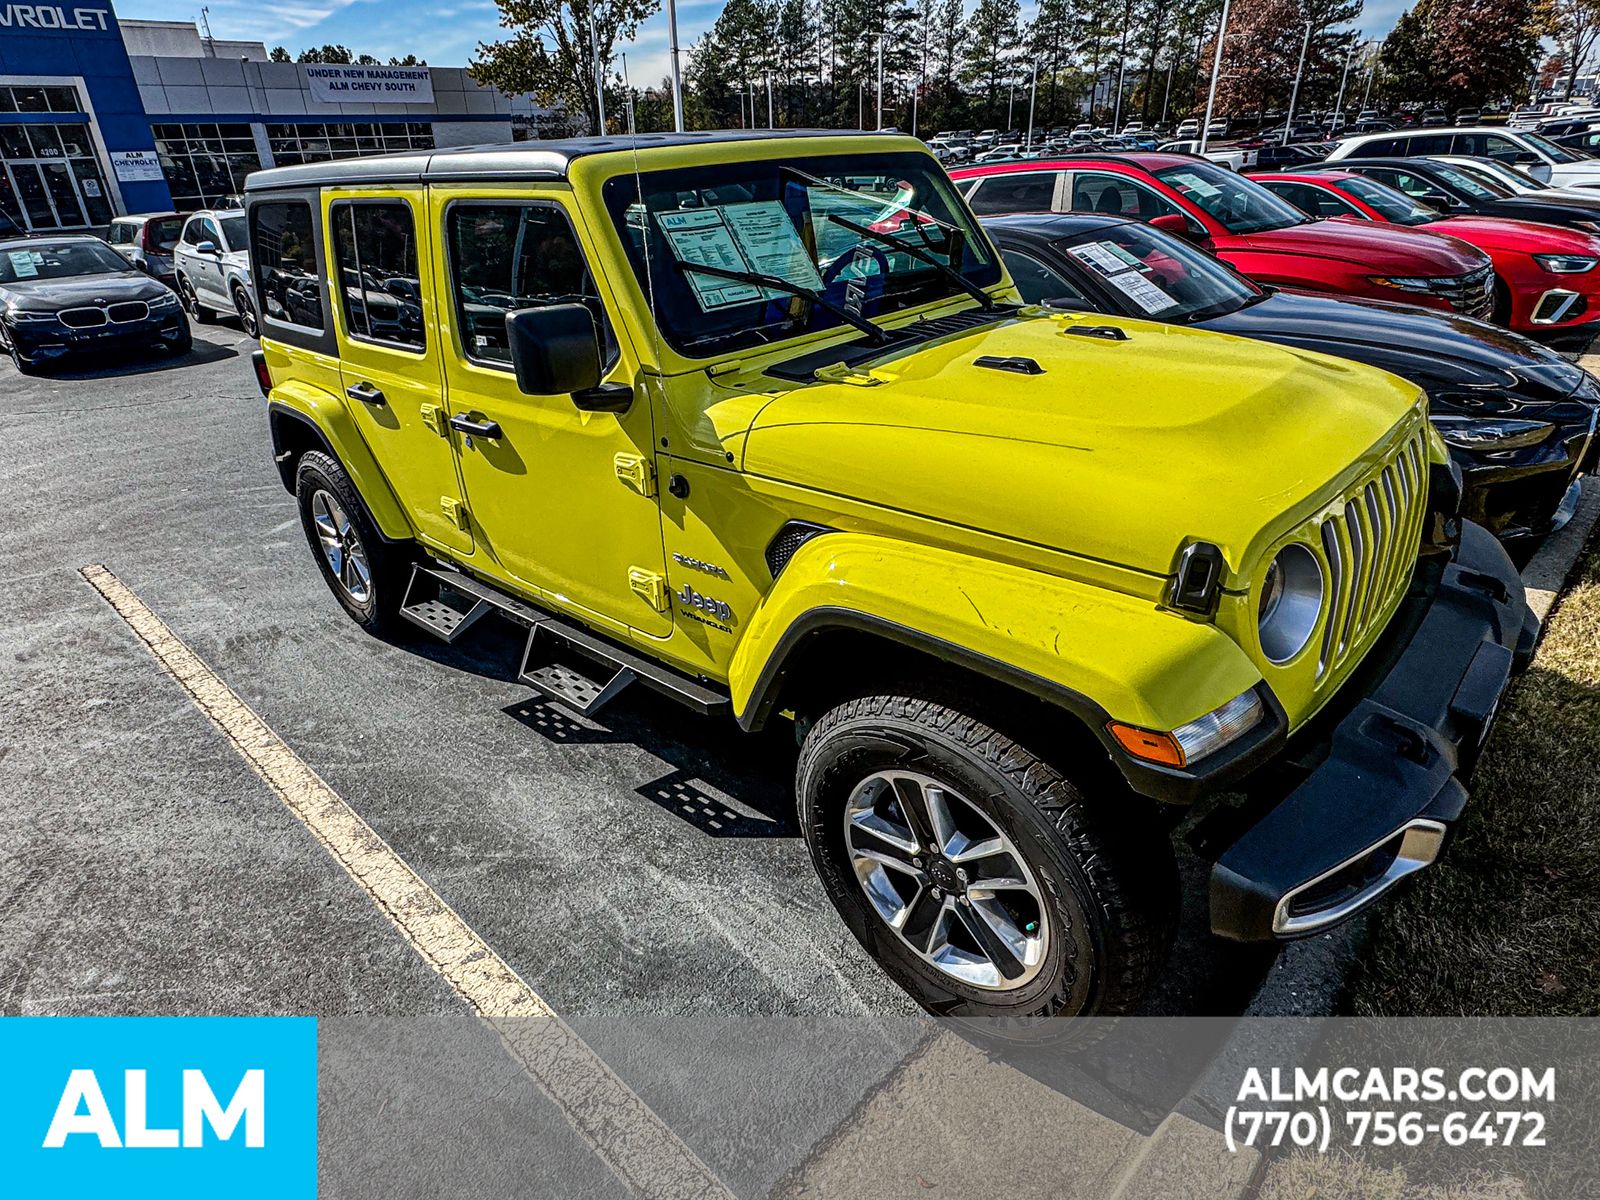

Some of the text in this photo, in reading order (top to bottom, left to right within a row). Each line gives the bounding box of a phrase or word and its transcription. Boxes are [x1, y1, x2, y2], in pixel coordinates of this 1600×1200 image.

[307, 69, 428, 80] UNDER NEW MANAGEMENT
[329, 82, 416, 91] ALM CHEVY SOUTH
[40, 148, 59, 156] 4200
[666, 216, 687, 226] ALM
[677, 583, 731, 622] Jeep
[680, 608, 733, 634] WRANGLER
